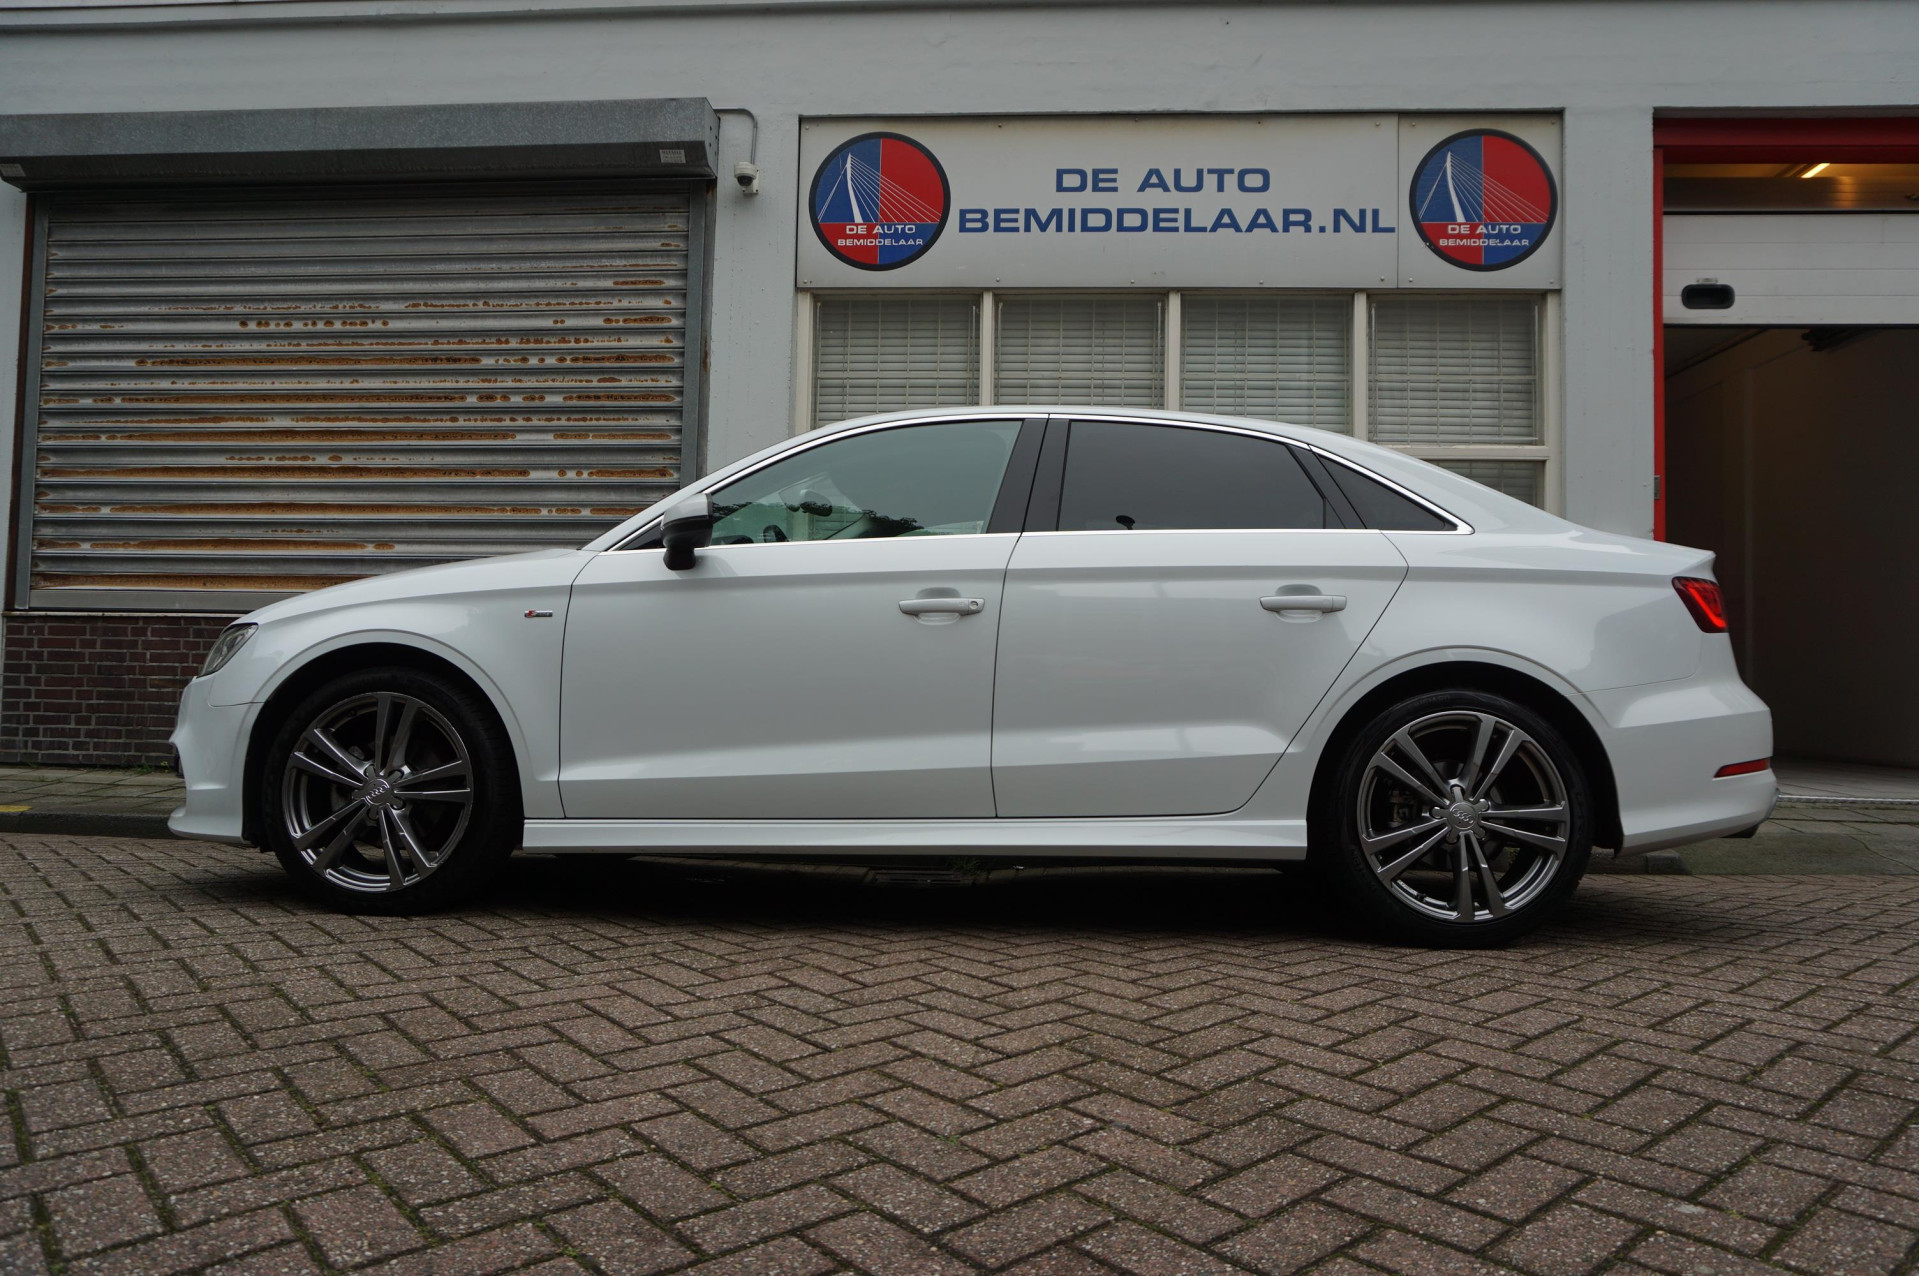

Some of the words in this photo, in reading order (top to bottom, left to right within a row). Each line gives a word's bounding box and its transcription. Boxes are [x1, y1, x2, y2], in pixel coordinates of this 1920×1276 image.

[1055, 168, 1118, 193] DE
[1138, 168, 1270, 193] AUTO
[959, 207, 1396, 233] BEMIDDELAAR.NL
[846, 225, 867, 234] DE
[873, 225, 915, 234] AUTO
[1448, 225, 1470, 234] DE
[1476, 225, 1521, 234] AUTO
